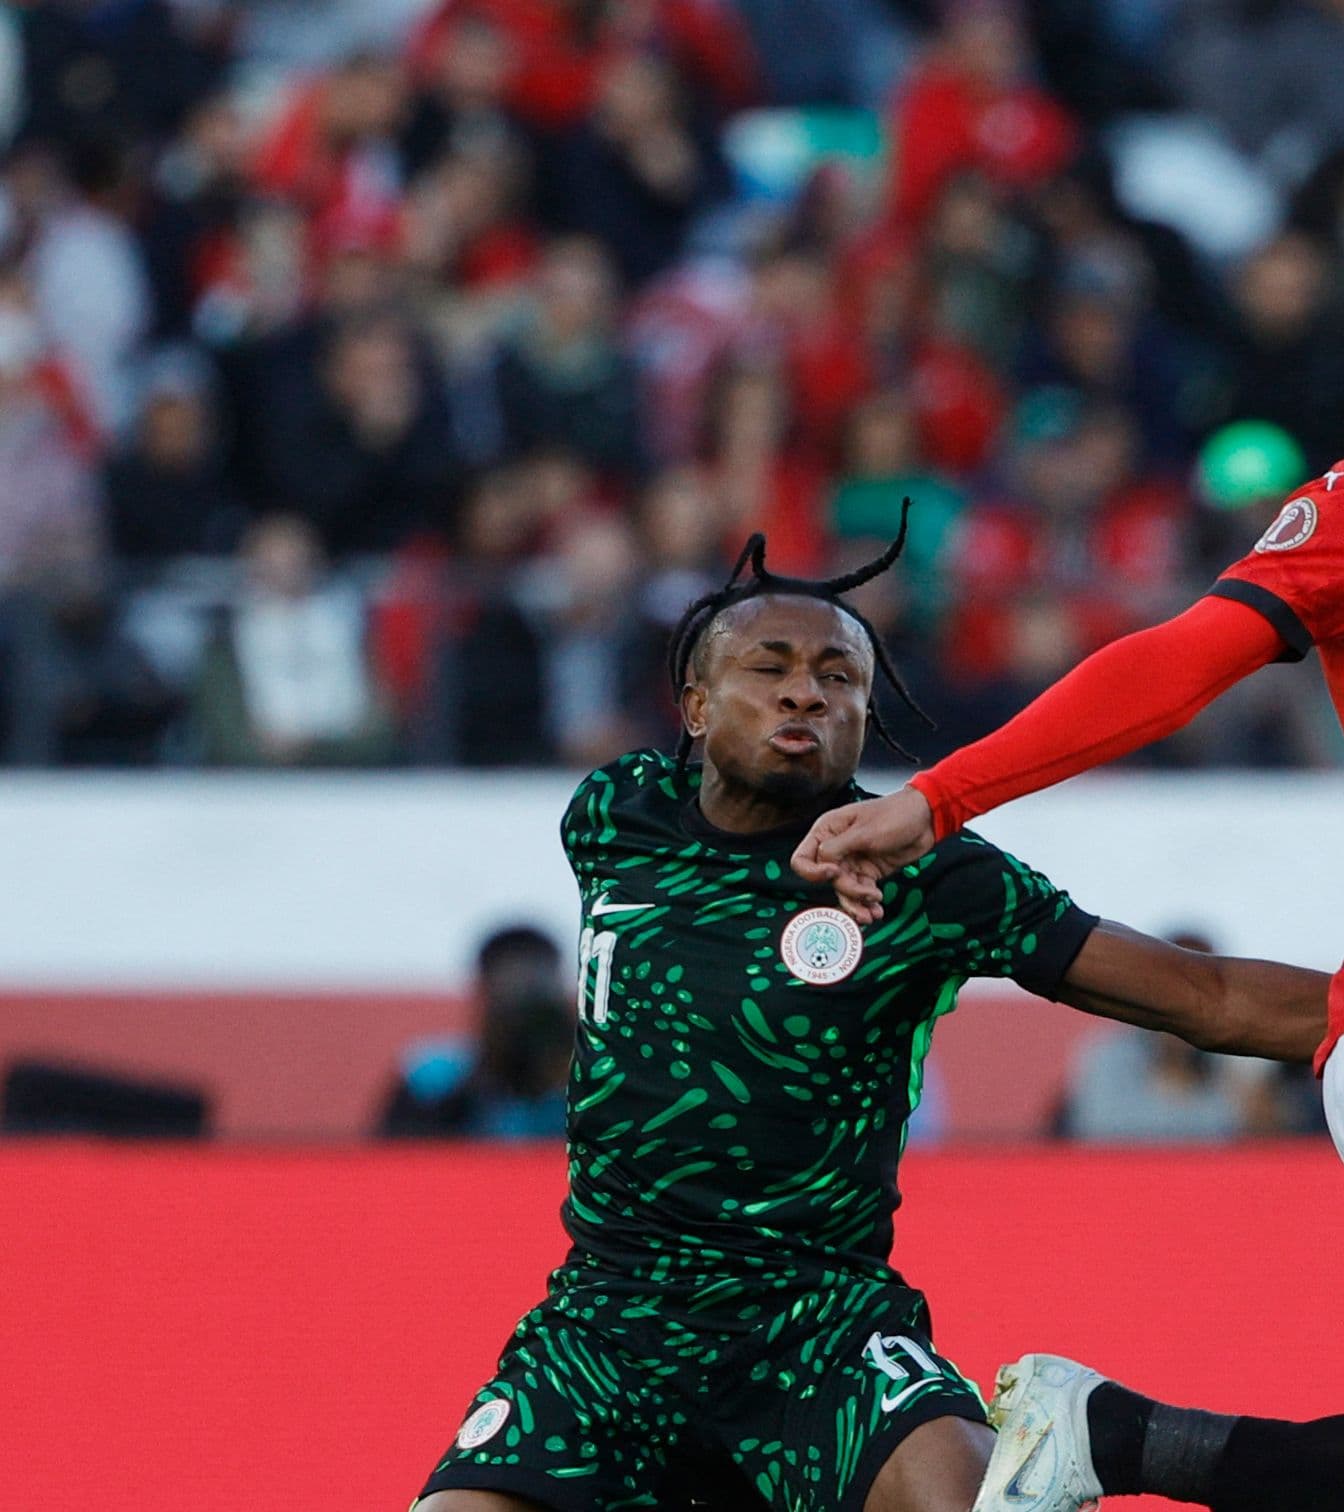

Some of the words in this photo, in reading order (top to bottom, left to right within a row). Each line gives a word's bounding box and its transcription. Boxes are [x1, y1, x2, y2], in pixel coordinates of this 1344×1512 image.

[784, 930, 797, 966] NIGERIA
[793, 911, 841, 929] FOOTBALL
[839, 916, 859, 973] FEDERATION
[578, 927, 617, 1024] 11
[807, 970, 828, 979] 1945
[861, 1331, 941, 1380] 11
